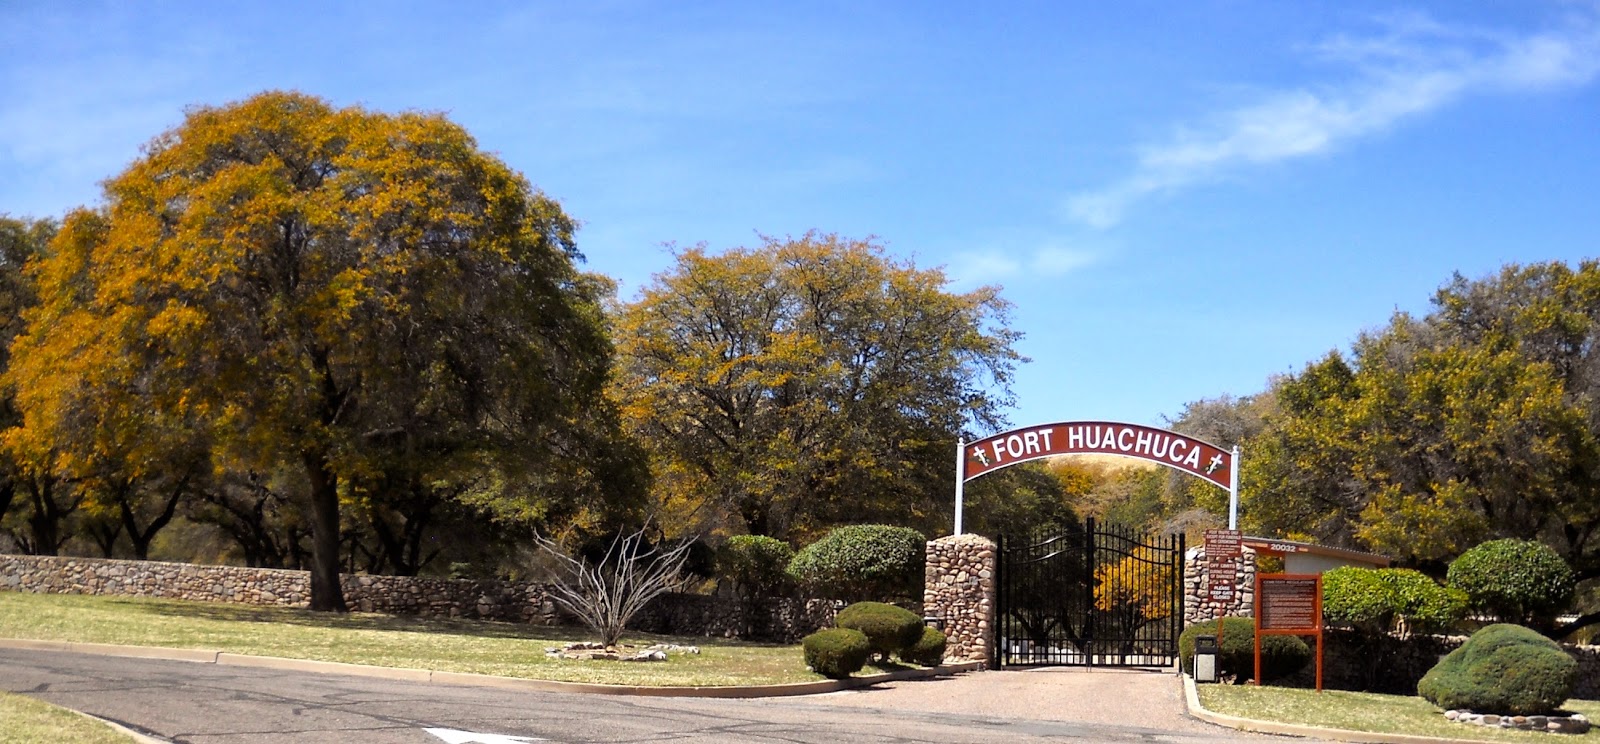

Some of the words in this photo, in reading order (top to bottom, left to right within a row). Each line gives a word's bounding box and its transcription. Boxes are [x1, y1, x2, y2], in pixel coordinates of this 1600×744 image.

[992, 428, 1053, 462] FORT
[1068, 426, 1200, 469] HUACHUCA
[1271, 543, 1296, 552] 20032
